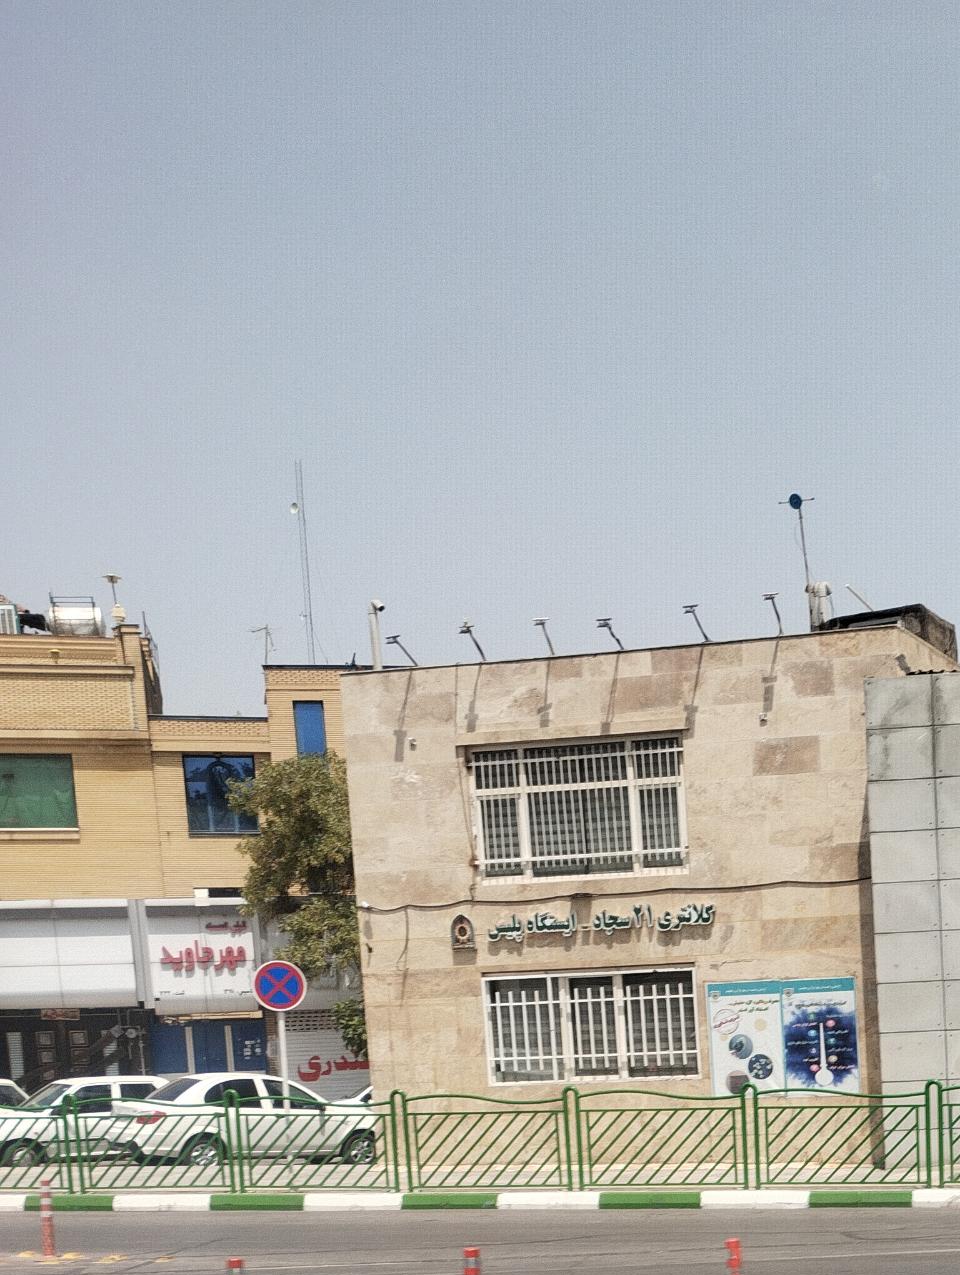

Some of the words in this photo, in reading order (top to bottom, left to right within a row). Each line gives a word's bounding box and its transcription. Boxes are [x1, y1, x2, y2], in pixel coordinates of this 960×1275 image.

[488, 913, 523, 942] پلیس
[527, 911, 578, 938] ایستگاه
[593, 909, 630, 935] سجاد
[633, 904, 653, 928] ۲۱
[657, 903, 715, 931] کلانتری
[160, 940, 213, 971] جاوید
[213, 946, 246, 970] مهر
